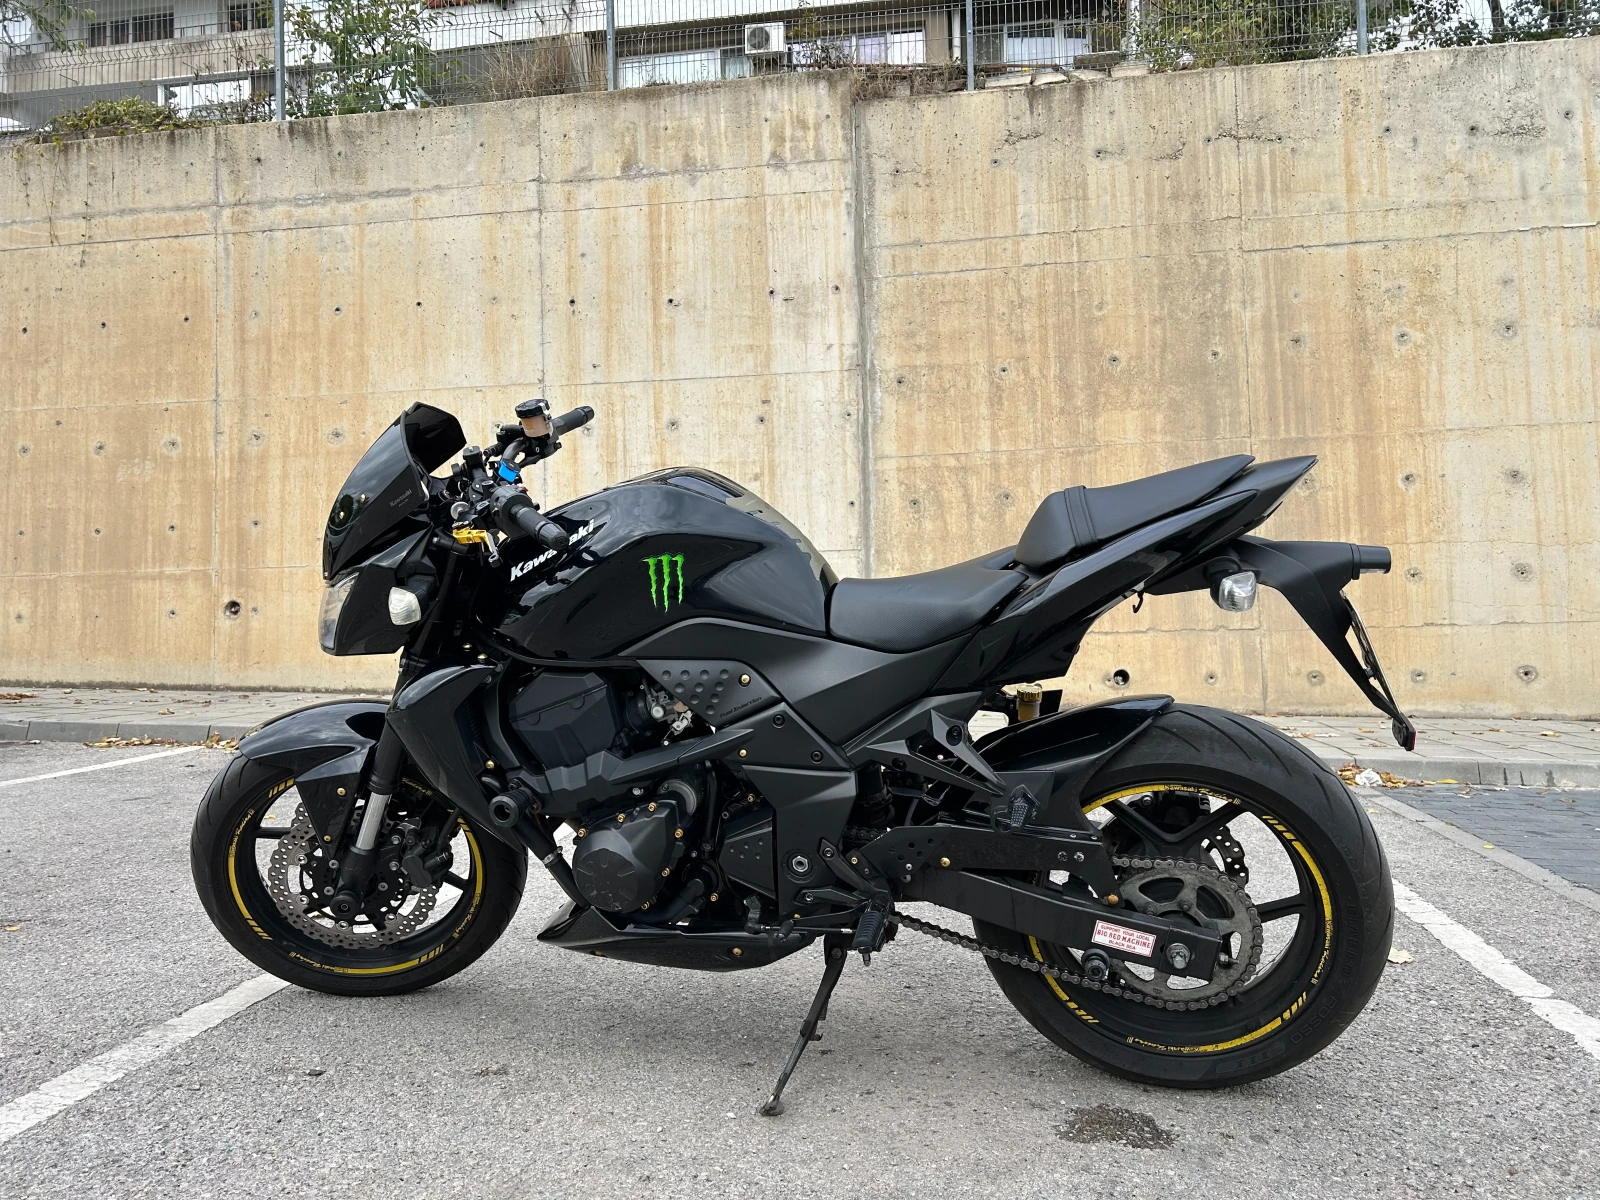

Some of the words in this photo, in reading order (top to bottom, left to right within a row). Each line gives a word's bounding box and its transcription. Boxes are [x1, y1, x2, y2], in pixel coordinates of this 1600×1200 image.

[510, 519, 595, 582] Kawaaki
[1097, 929, 1108, 937] BIG
[1109, 932, 1121, 940] RED
[1121, 935, 1152, 949] MACHINE
